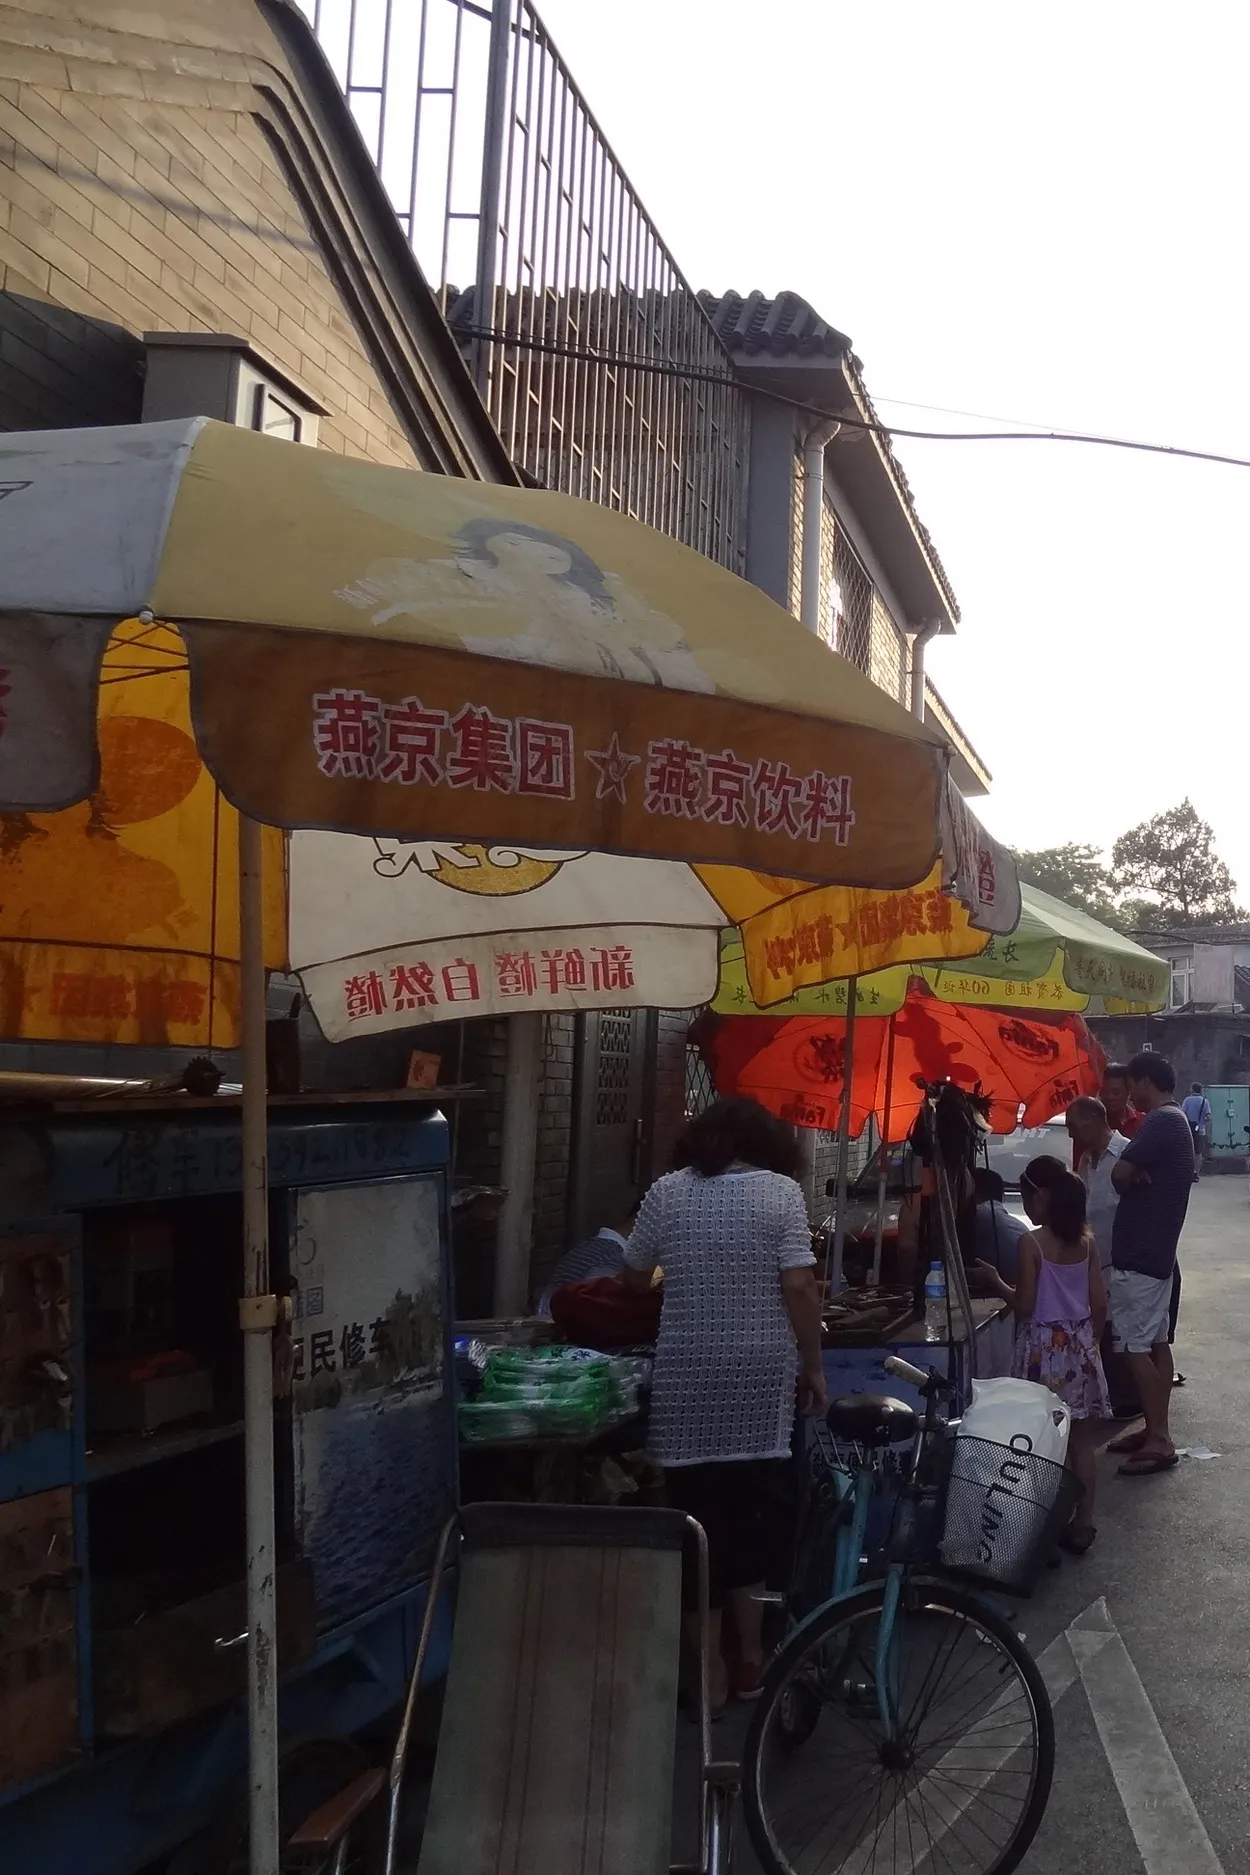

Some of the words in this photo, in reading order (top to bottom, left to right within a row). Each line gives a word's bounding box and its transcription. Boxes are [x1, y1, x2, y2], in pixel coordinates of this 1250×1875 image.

[312, 687, 577, 802] 燕京集团
[644, 737, 857, 847] 燕京饮料
